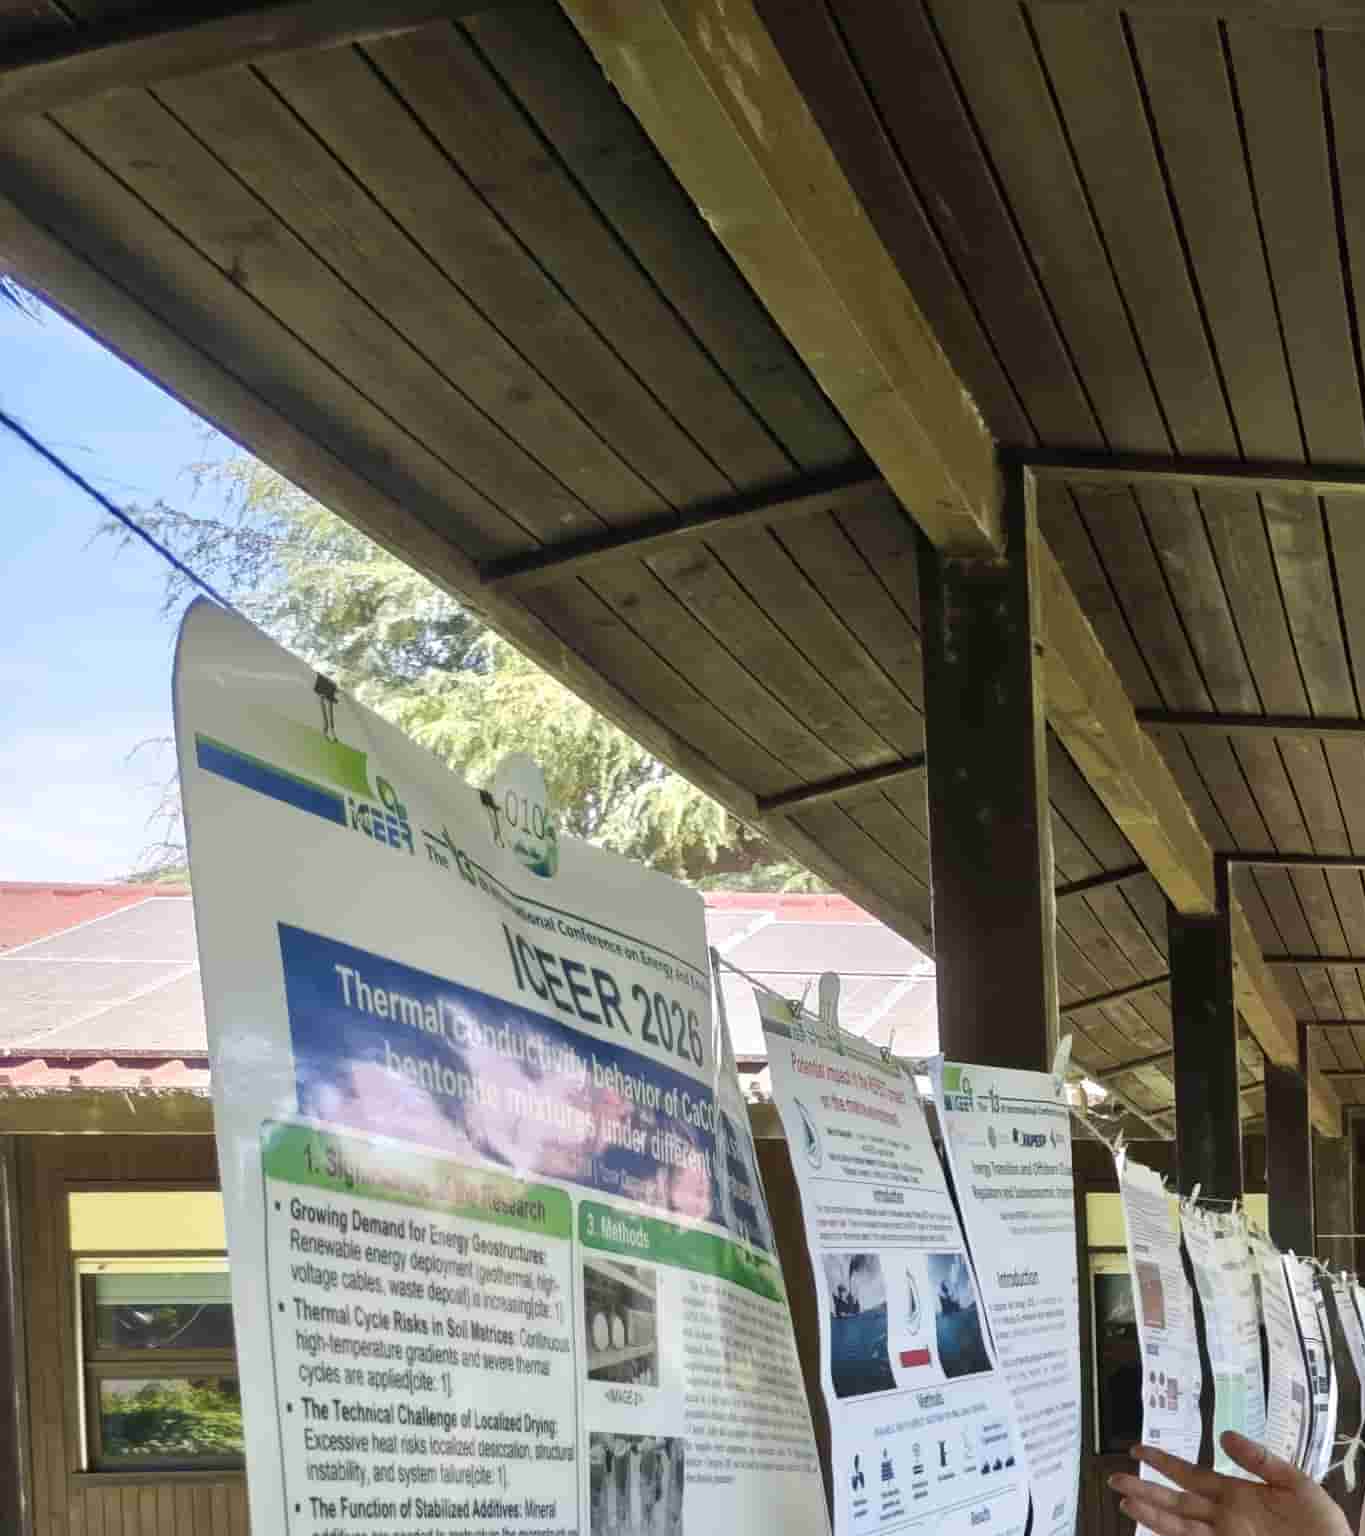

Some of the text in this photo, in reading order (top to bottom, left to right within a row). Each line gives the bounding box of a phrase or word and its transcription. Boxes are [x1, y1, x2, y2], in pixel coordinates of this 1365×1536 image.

[502, 920, 705, 1068] ICEER 2026
[334, 962, 447, 1035] Thermal
[592, 1053, 661, 1110] behavior
[664, 1086, 682, 1116] of
[290, 1197, 348, 1235] Growing
[352, 1208, 405, 1239] Demand
[408, 1217, 427, 1243] for
[430, 1223, 469, 1257] Energy
[601, 1215, 650, 1250] Methods
[290, 1226, 362, 1262] Renewable
[366, 1246, 407, 1273] energy
[290, 1259, 338, 1291] voltage
[388, 1278, 425, 1300] waste
[292, 1296, 352, 1328] Thermal
[354, 1304, 391, 1334] Cycle
[391, 1308, 430, 1336] Risks
[432, 1316, 445, 1338] in
[447, 1317, 470, 1341] Soil
[295, 1327, 403, 1361] high-temperature
[405, 1343, 459, 1367] gradients
[461, 1349, 481, 1370] and
[298, 1360, 341, 1388] cycles
[343, 1367, 365, 1386] are
[300, 1396, 329, 1422] The
[331, 1398, 395, 1426] Technical
[397, 1402, 457, 1434] Challenge
[459, 1407, 473, 1429] of
[474, 1408, 522, 1434] Localized
[303, 1427, 369, 1453] Excessive
[371, 1430, 397, 1454] heat
[400, 1431, 427, 1456] risks
[429, 1434, 476, 1457] localized
[305, 1459, 370, 1489] instability,
[372, 1460, 395, 1484] and
[397, 1463, 438, 1489] system
[309, 1495, 337, 1520] The
[340, 1494, 398, 1520] Function
[399, 1494, 412, 1520] of
[414, 1494, 470, 1520] Stabilized
